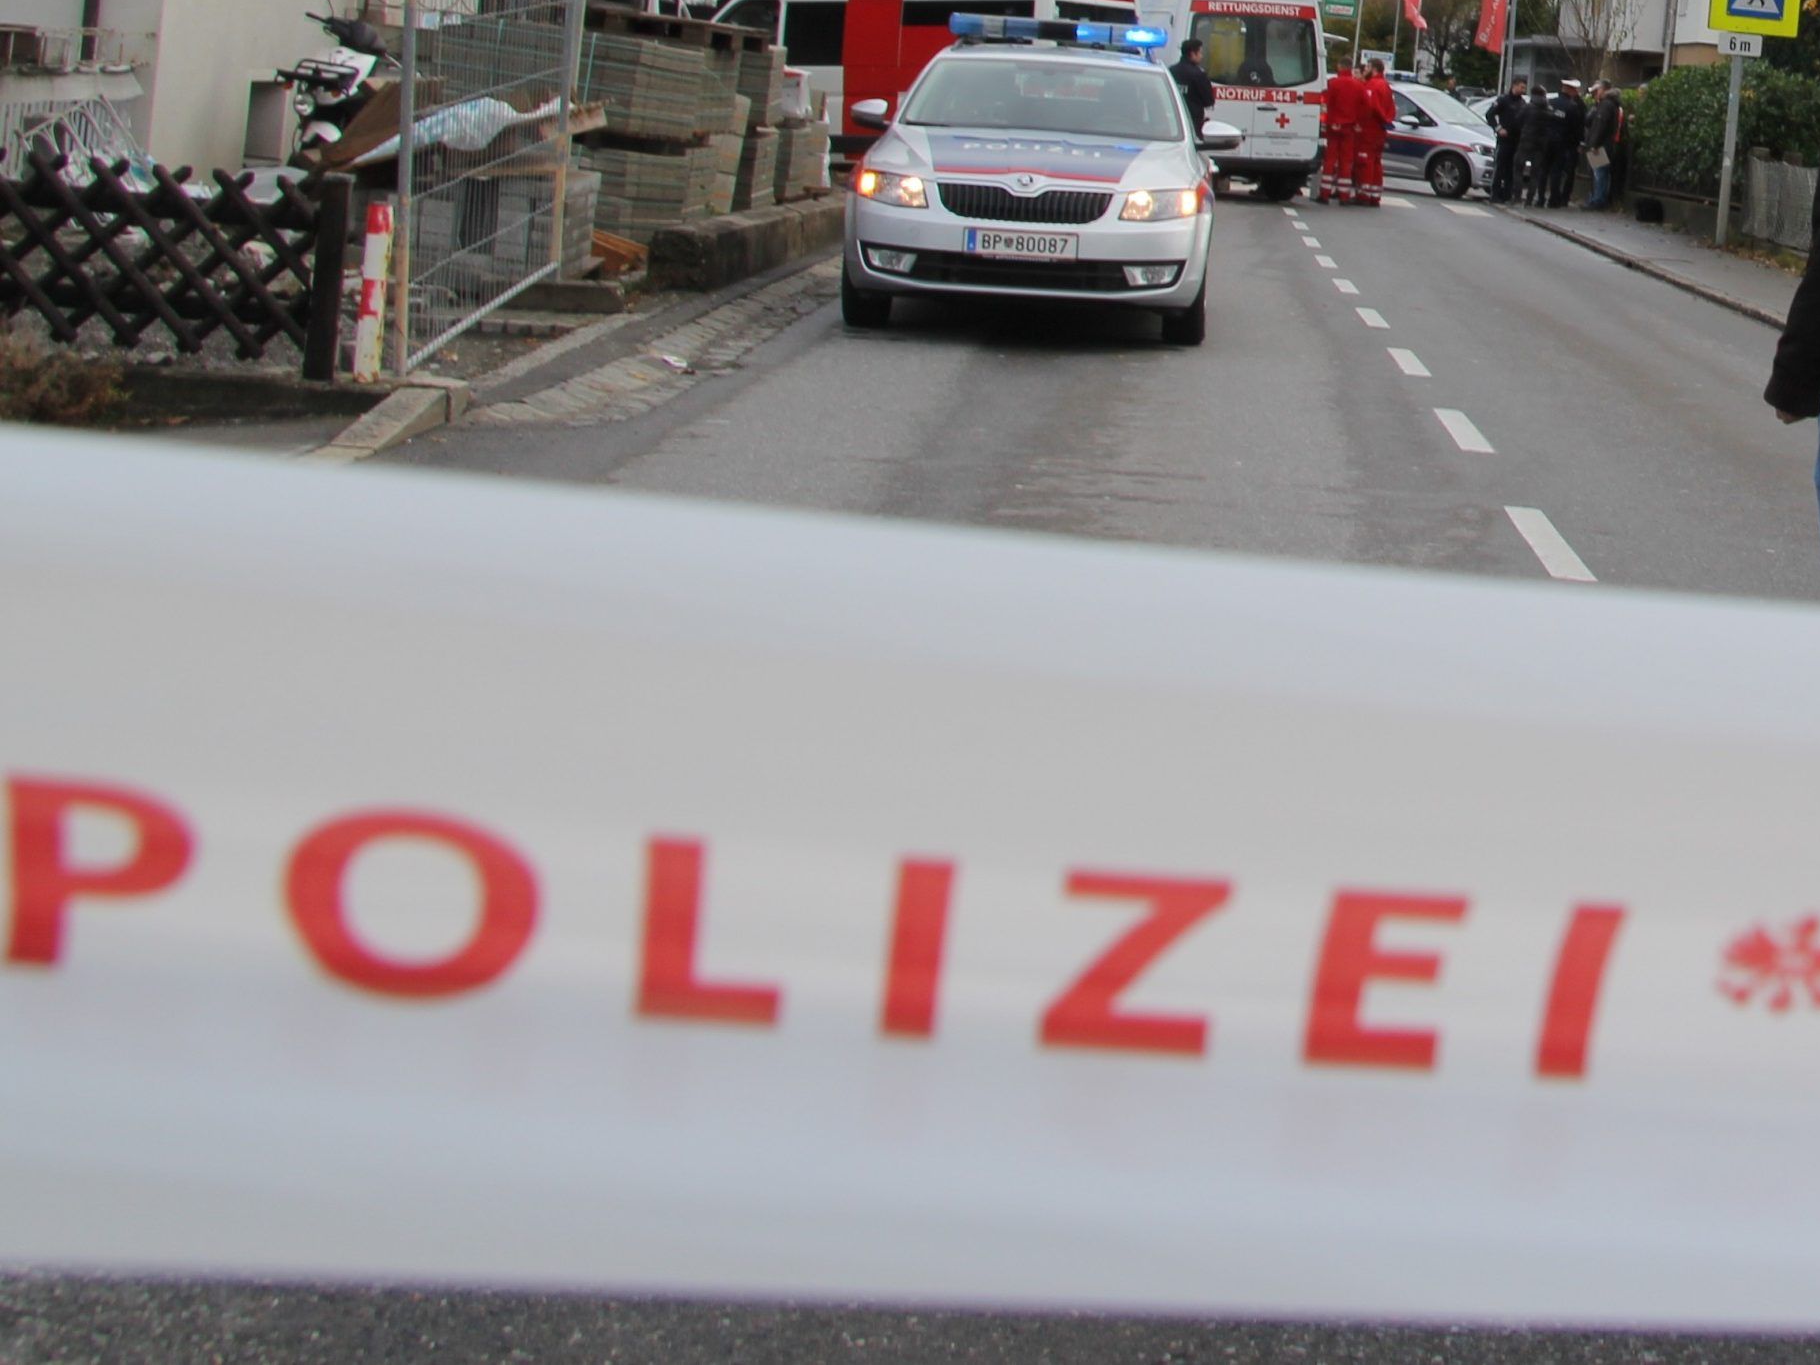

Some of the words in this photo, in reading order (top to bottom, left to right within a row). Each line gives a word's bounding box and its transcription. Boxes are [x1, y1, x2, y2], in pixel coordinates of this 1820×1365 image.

[1208, 1, 1301, 17] RETTUNGSDIENST
[1730, 36, 1737, 51] 6
[1739, 40, 1751, 52] m
[1216, 88, 1266, 101] NOTRUF
[1272, 90, 1291, 102] 144
[963, 141, 1101, 159] POLIZEI
[8, 775, 1626, 1079] POLIZEI
